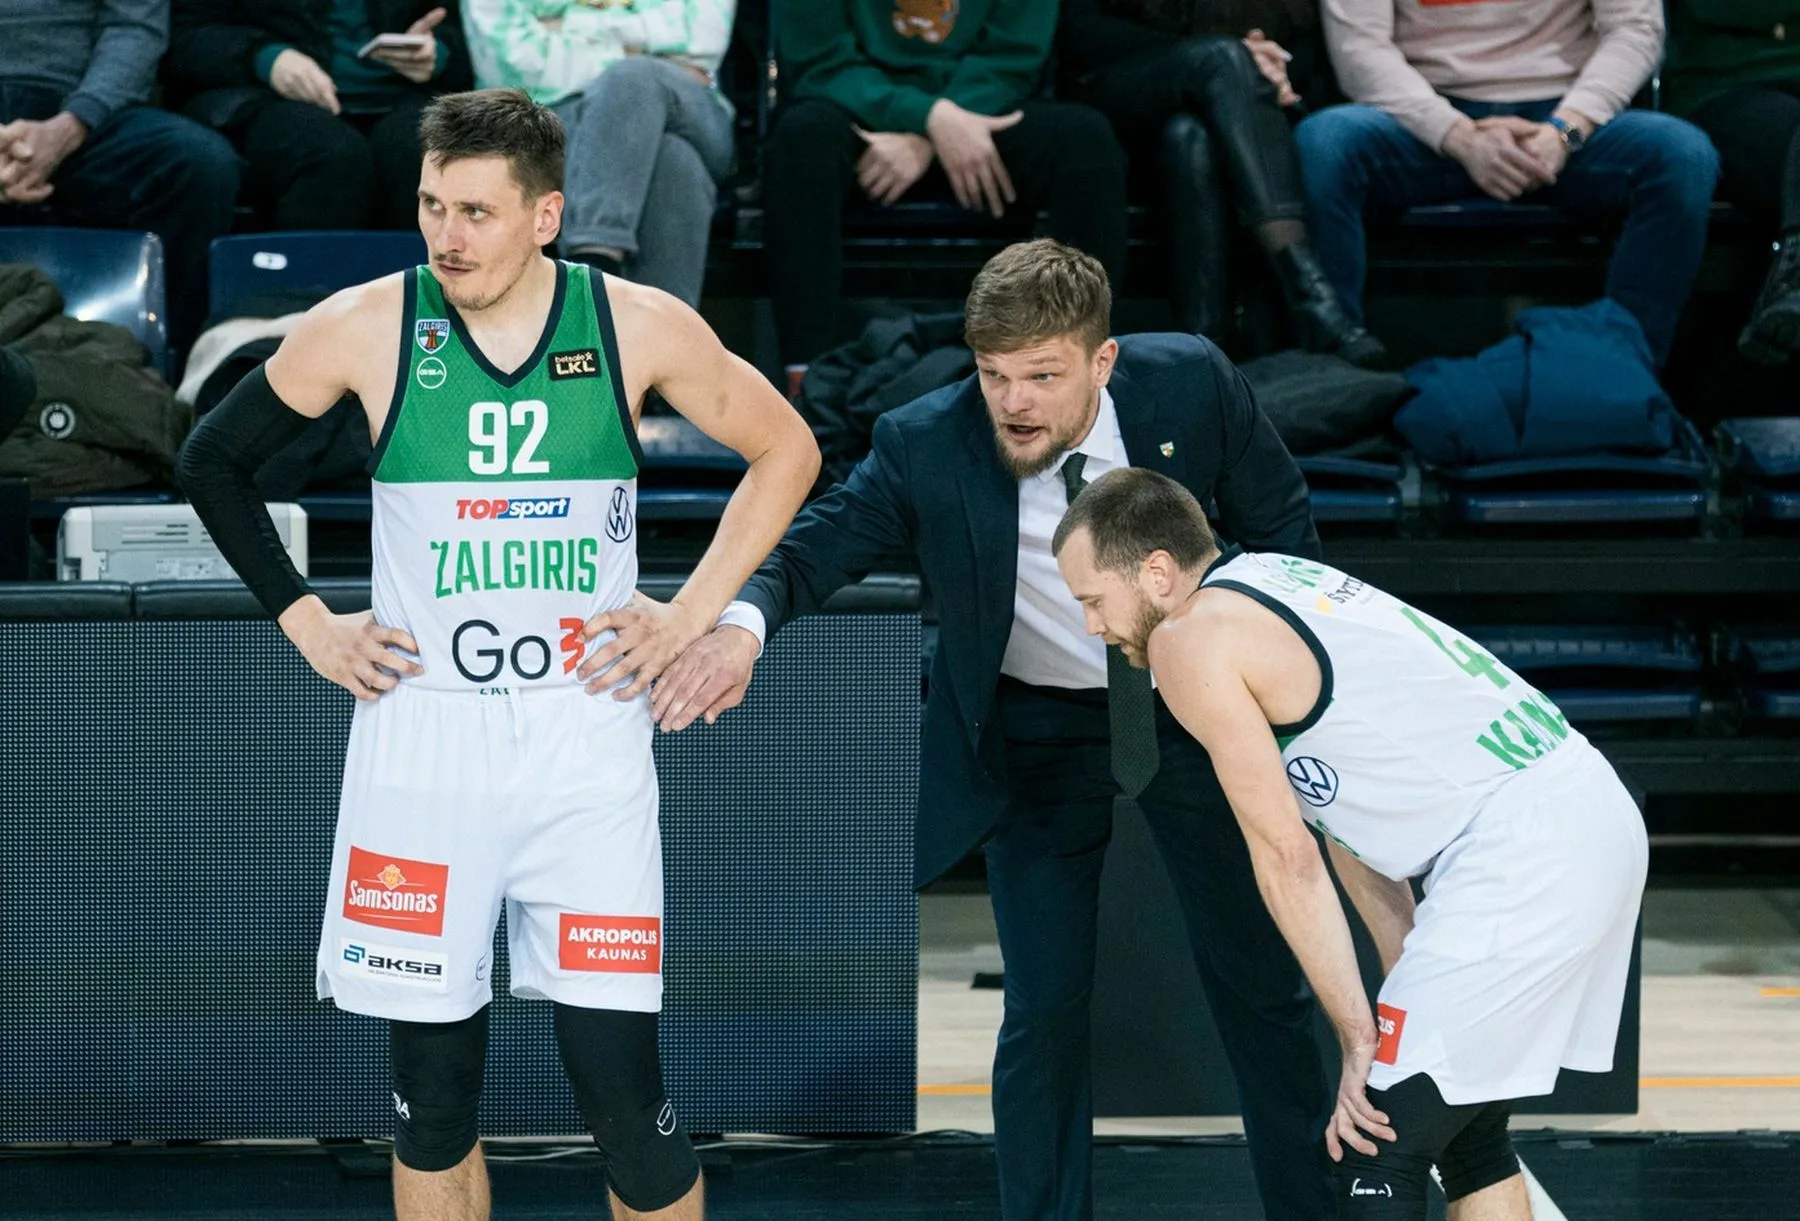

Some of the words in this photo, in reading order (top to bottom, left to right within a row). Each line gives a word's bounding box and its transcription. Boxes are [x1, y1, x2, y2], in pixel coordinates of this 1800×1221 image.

[556, 361, 596, 375] LKL
[468, 399, 549, 475] 92
[1400, 606, 1511, 690] 4
[348, 879, 438, 913] Samsonas
[568, 927, 657, 945] AKROPOLIS
[587, 948, 647, 961] KAUNAS
[368, 955, 442, 976] aksa
